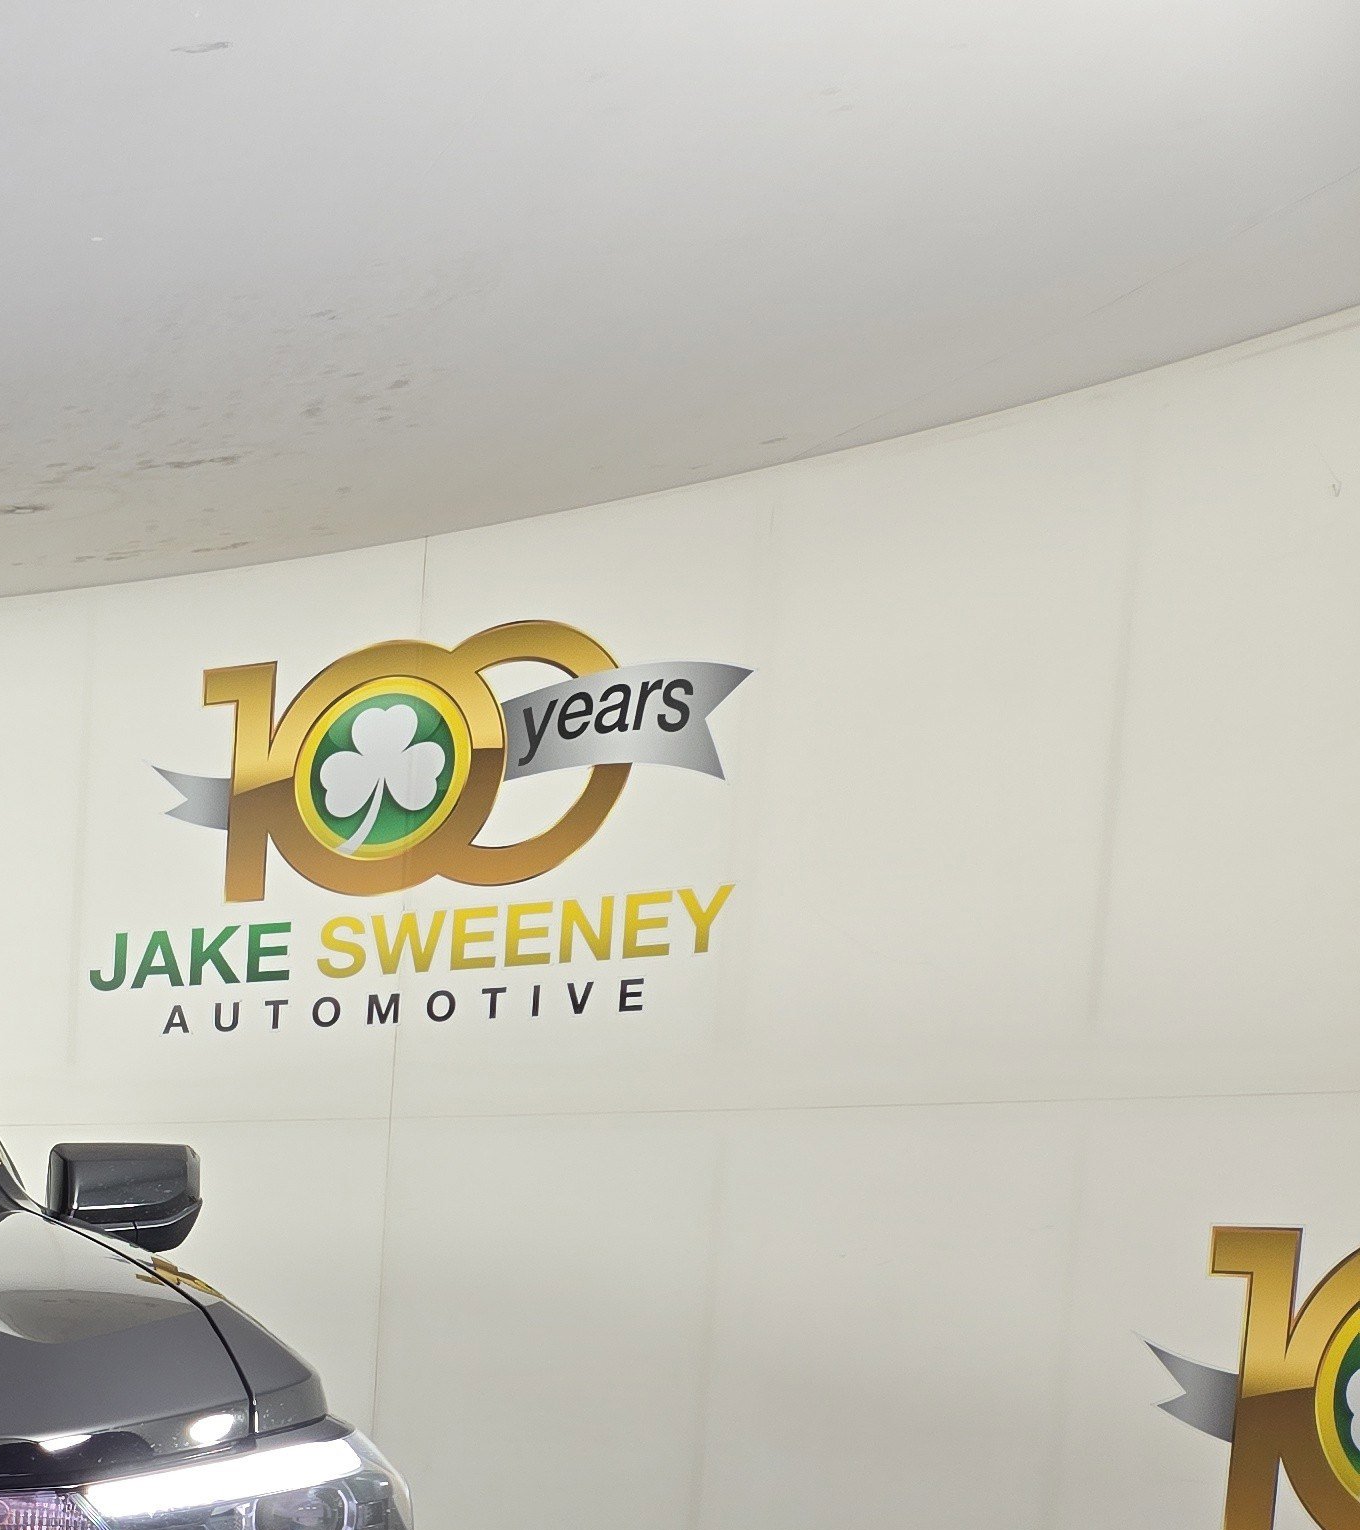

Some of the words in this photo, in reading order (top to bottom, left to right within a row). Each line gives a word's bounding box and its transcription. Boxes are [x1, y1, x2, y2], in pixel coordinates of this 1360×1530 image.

[518, 677, 695, 767] years
[89, 921, 292, 992] JAKE
[316, 884, 735, 980] SWEENEY
[162, 978, 645, 1035] AUTOMOTIVE
